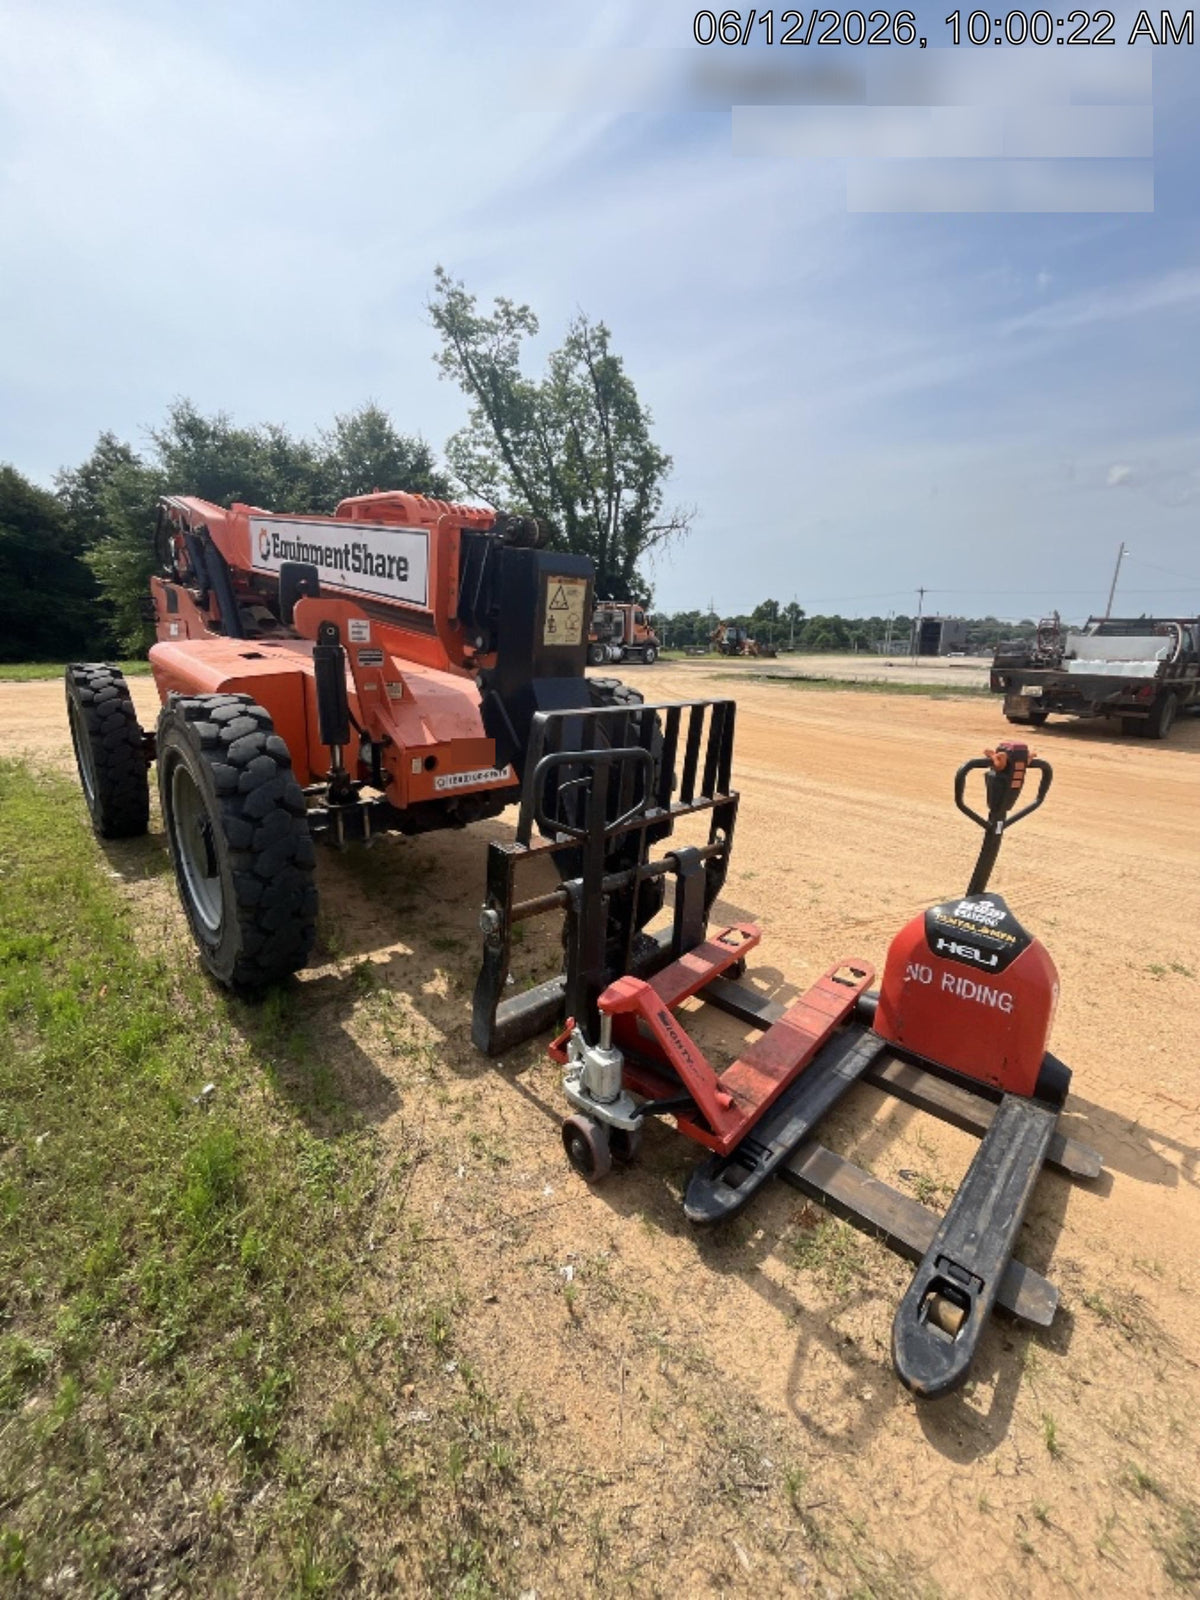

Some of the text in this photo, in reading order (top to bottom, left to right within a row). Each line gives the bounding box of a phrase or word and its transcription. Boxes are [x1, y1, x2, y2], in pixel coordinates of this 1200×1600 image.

[271, 532, 410, 582] EquipmentShare
[904, 962, 1014, 1014] NO RIDING
